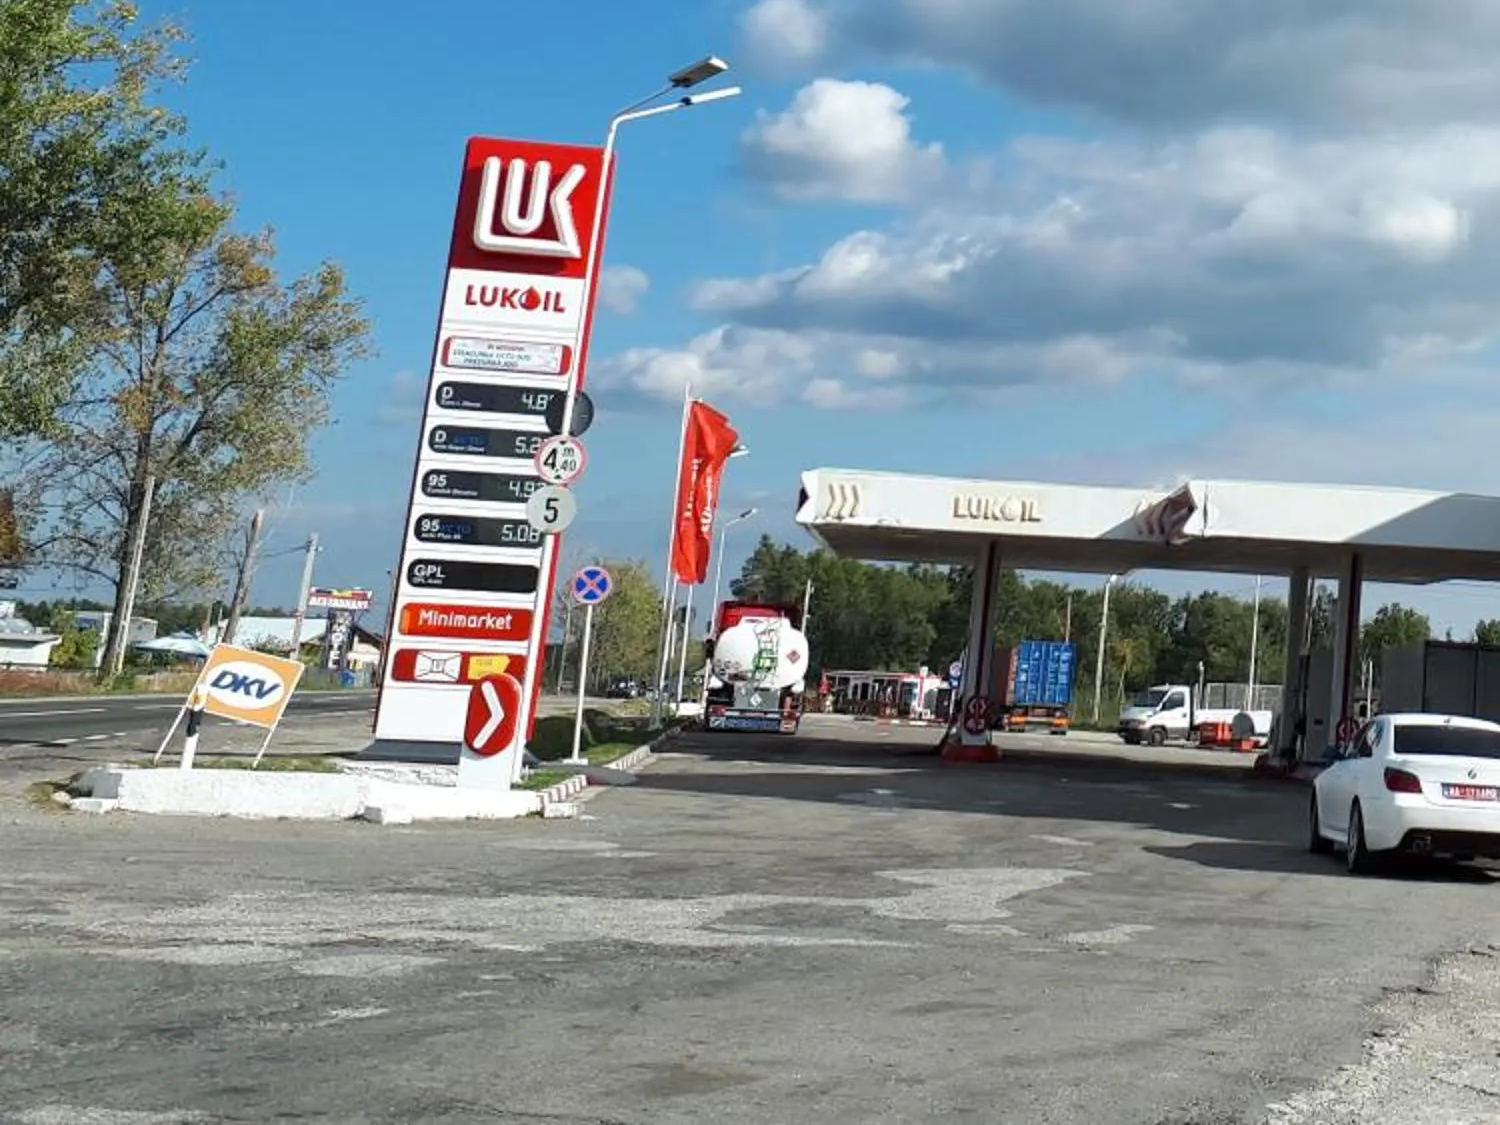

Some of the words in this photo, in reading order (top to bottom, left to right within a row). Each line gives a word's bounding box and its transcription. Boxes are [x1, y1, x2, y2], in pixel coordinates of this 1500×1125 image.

[464, 283, 566, 313] LUKOIL
[442, 386, 454, 399] D
[521, 393, 554, 410] 4.8
[434, 430, 447, 442] D
[515, 436, 548, 455] 5.2
[428, 474, 448, 487] 95
[543, 497, 560, 524] 5
[421, 519, 441, 532] 95
[413, 564, 446, 578] GPL
[418, 609, 512, 630] Minimarket
[210, 670, 281, 700] DKV
